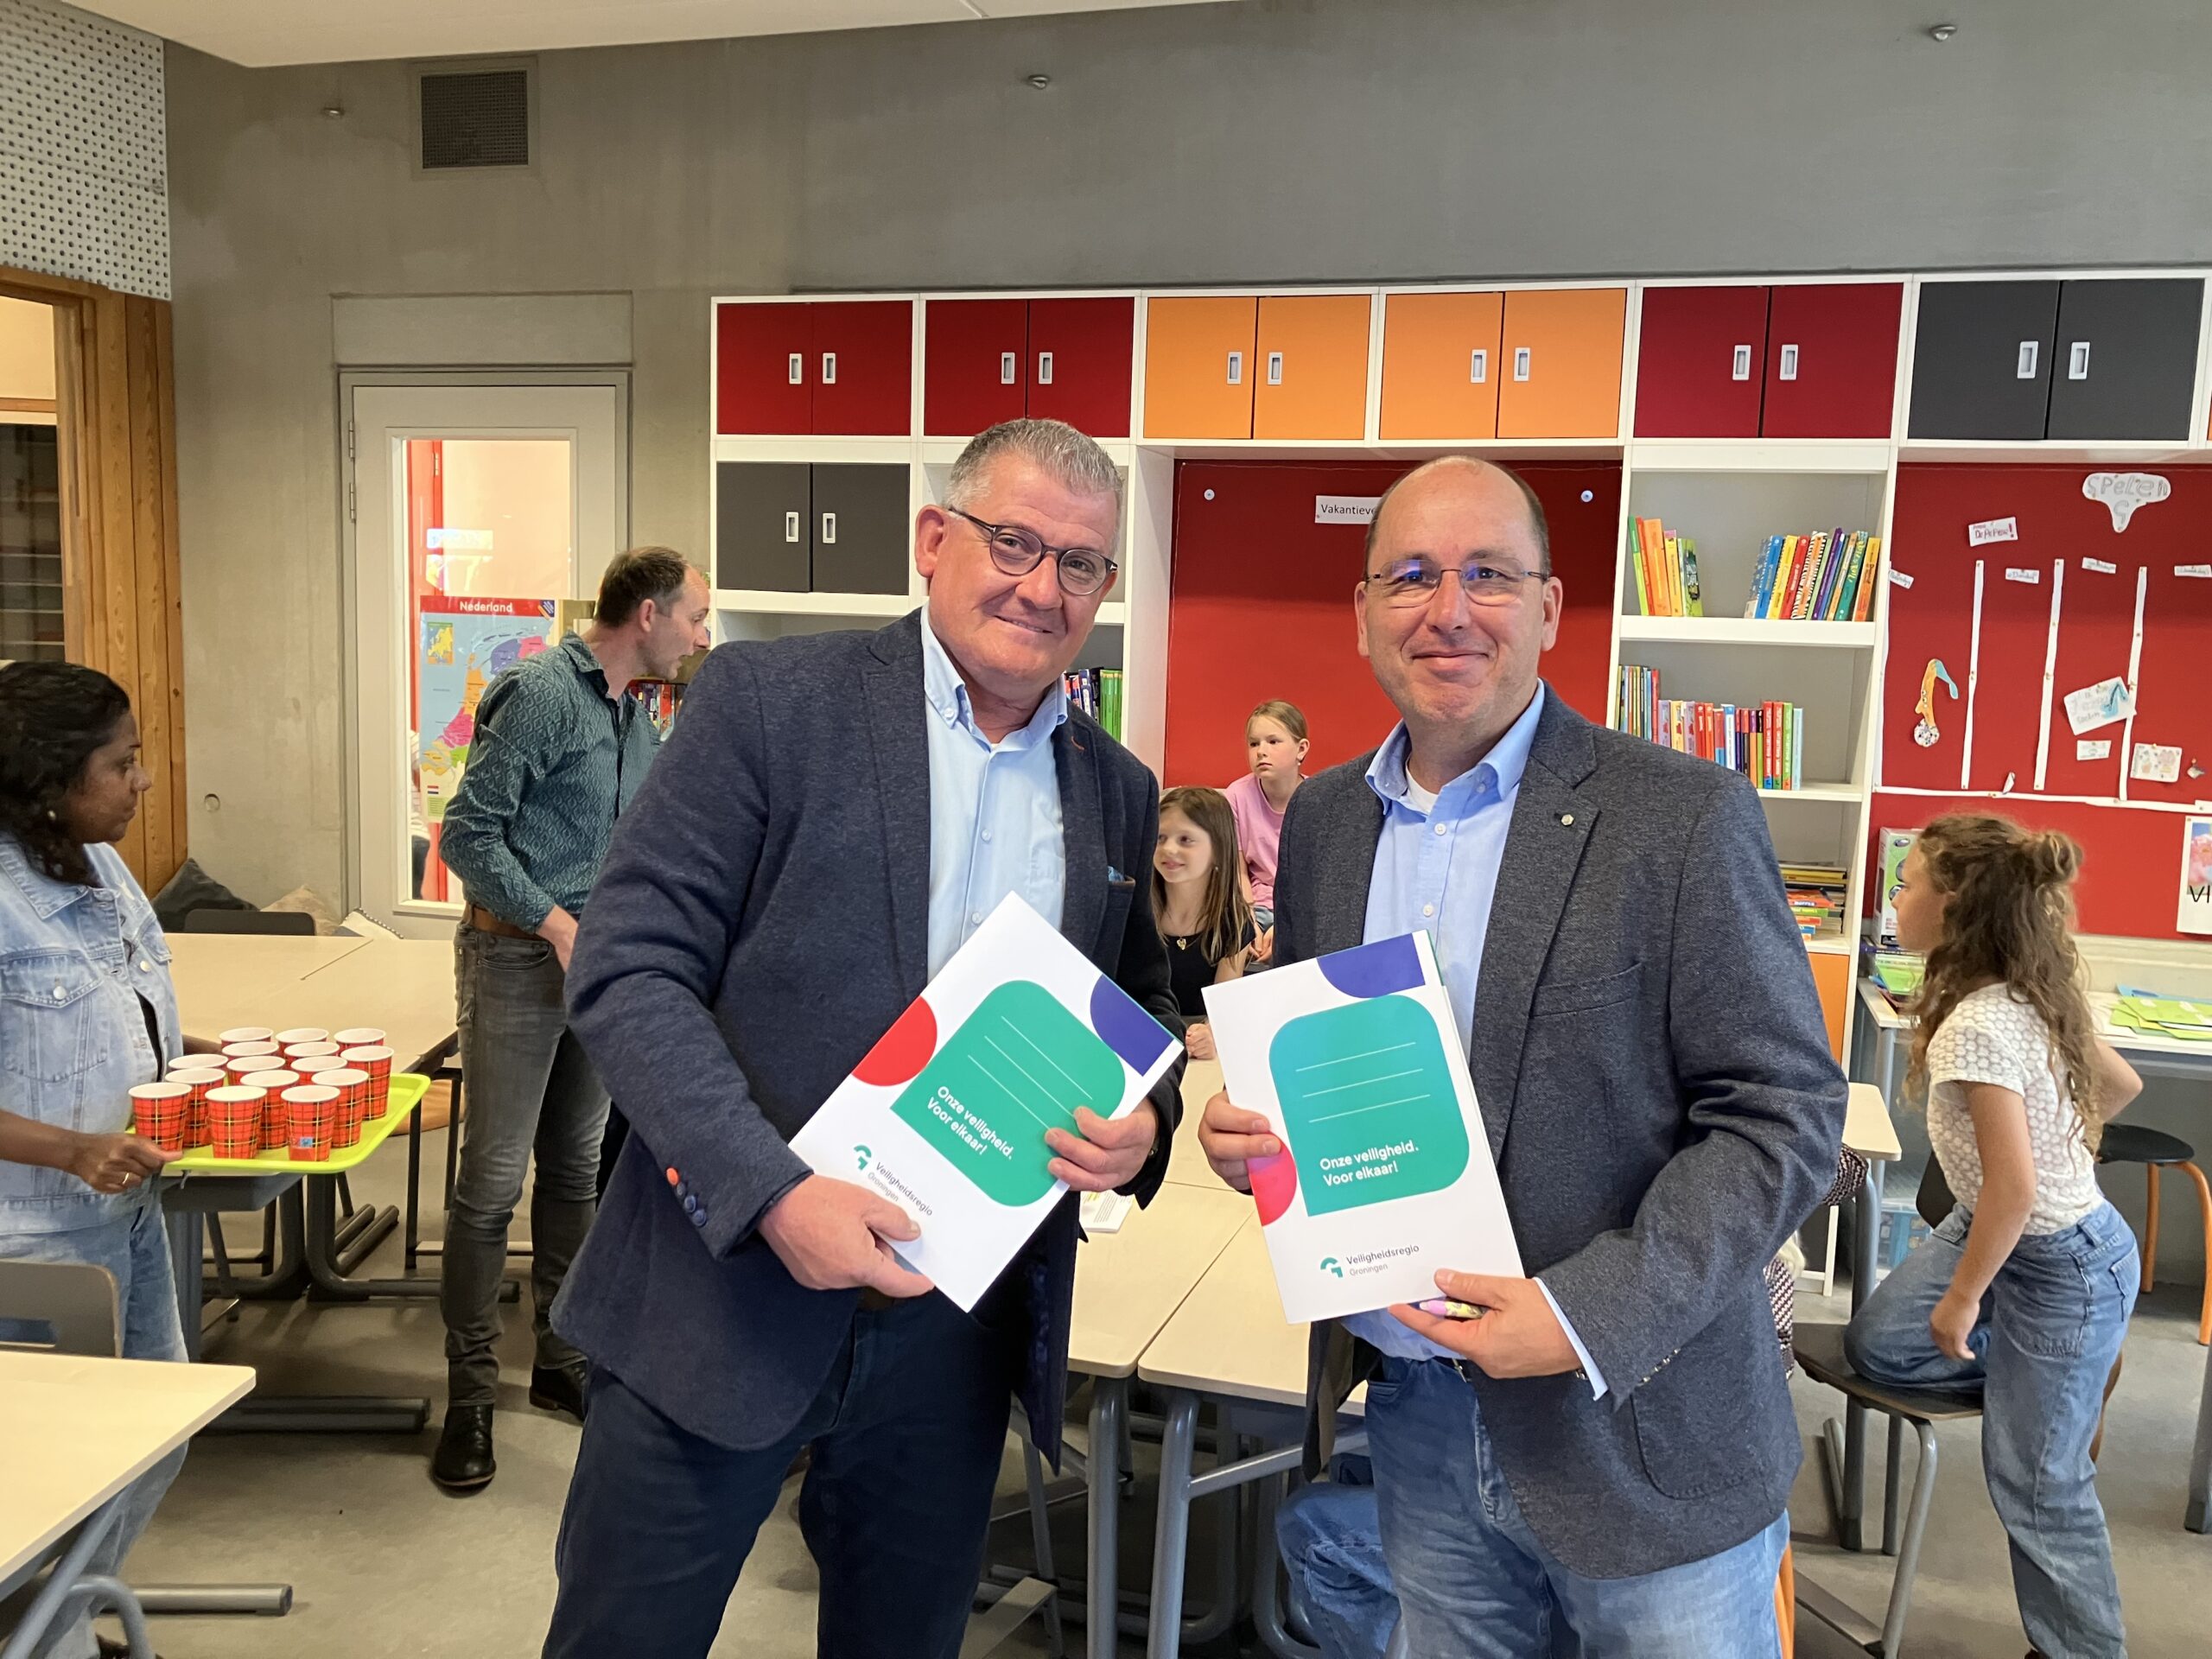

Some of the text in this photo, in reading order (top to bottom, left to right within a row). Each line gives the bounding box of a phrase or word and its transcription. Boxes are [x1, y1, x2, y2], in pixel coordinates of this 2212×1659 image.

[460, 601, 513, 613] Nederland
[926, 1097, 988, 1155] Voor elkaar!
[938, 1085, 1014, 1160] Onze veiligheid.
[1319, 1140, 1420, 1171] Onze veiligheid.
[868, 1172, 899, 1202] Groningen
[1323, 1160, 1399, 1186] Voor elkaar!
[875, 1161, 933, 1217] Veiligheidsregio
[1345, 1244, 1420, 1265] Veiligheidsregio
[1349, 1262, 1389, 1276] Groningen
